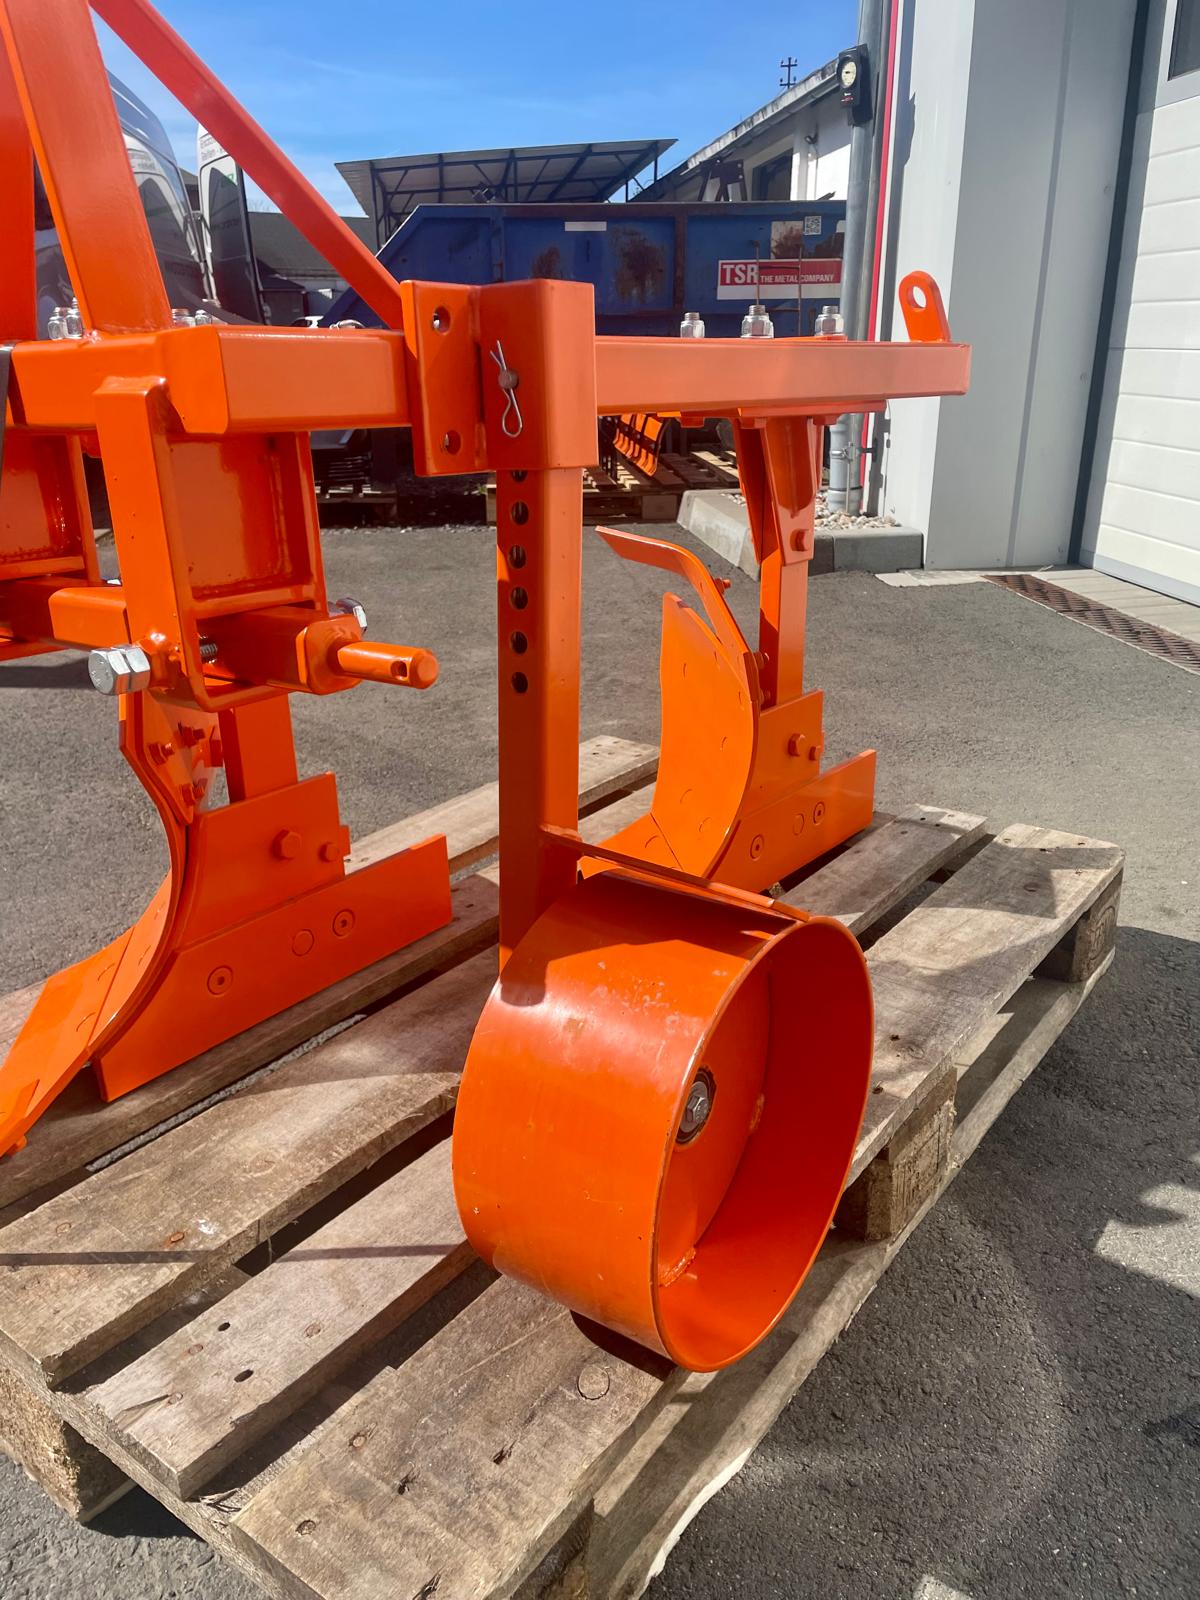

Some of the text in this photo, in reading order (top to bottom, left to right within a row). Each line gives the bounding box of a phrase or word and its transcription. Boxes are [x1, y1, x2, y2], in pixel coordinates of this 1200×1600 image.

[722, 264, 759, 284] TSR
[760, 274, 834, 284] THE METAL COMPANY
